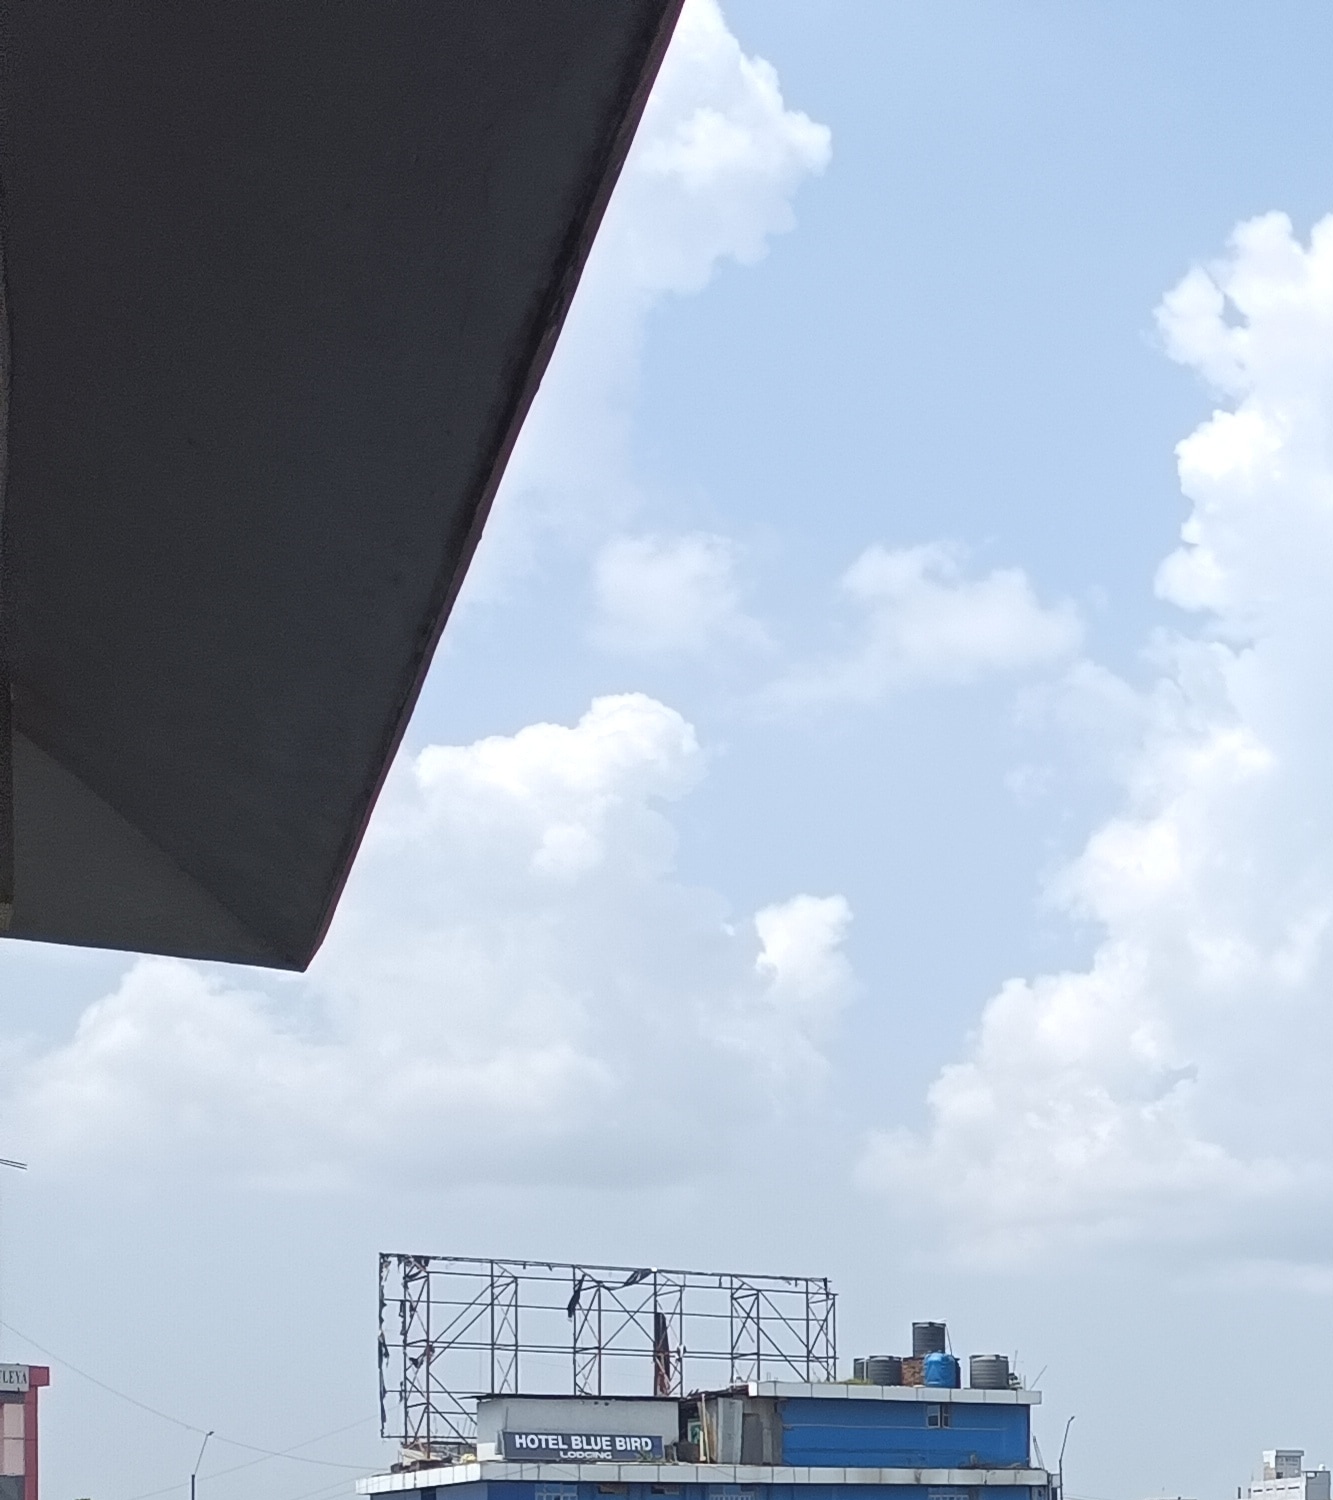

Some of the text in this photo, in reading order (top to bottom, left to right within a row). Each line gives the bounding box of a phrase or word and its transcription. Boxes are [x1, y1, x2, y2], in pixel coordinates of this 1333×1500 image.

[0, 1370, 27, 1384] LEYA
[515, 1434, 652, 1450] HOTEL BLUE BIRD
[560, 1451, 612, 1459] LODGING
